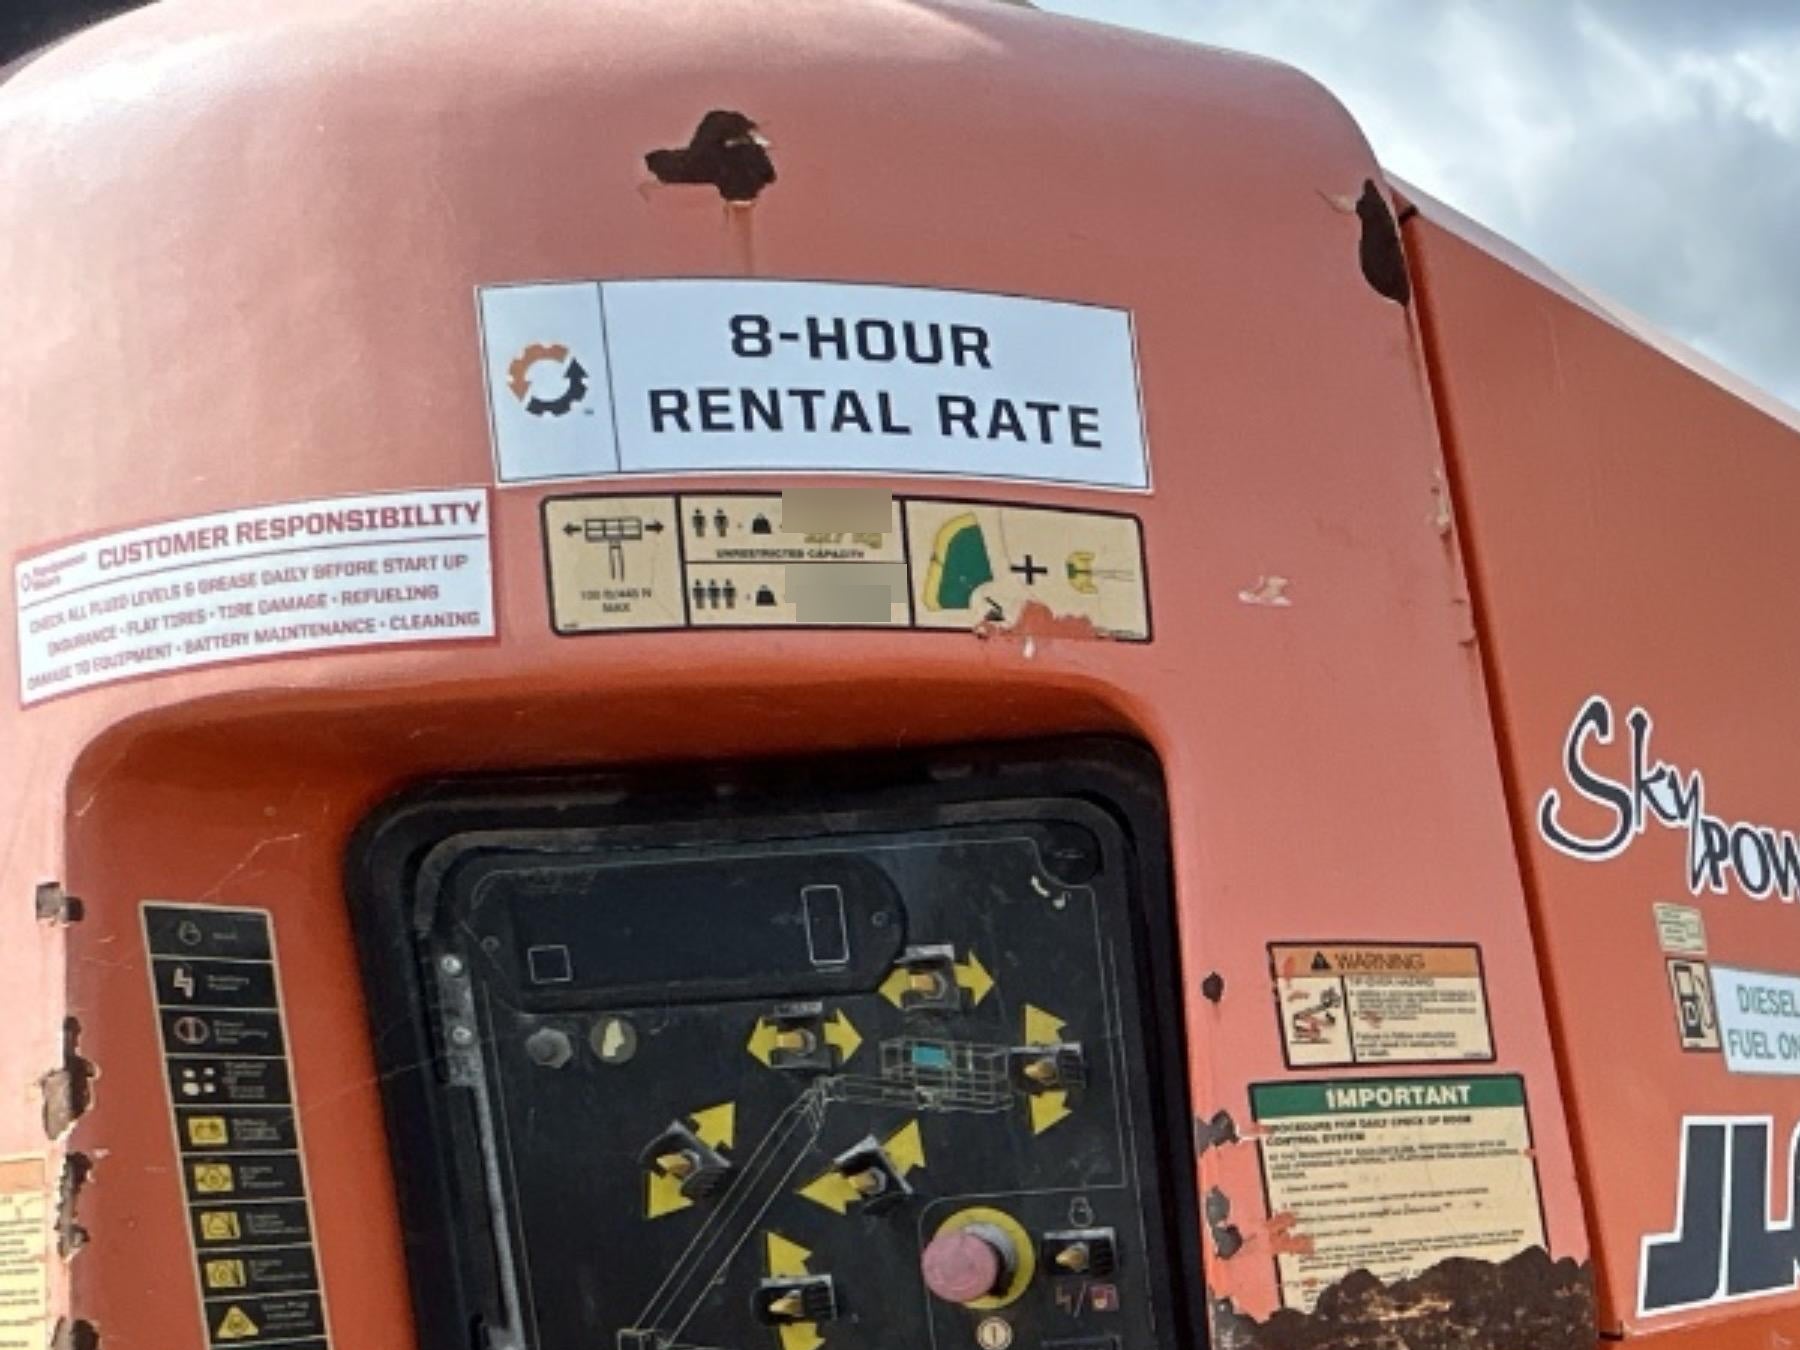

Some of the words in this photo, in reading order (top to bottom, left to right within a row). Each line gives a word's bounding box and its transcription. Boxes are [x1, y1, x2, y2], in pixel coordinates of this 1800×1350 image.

[729, 312, 992, 369] 8-HOUR
[649, 386, 913, 436] RENTAL
[938, 393, 1103, 449] RATE
[98, 525, 229, 570] CUSTOMER
[236, 501, 481, 543] RESPONSIBILITY
[198, 572, 257, 594] GREASE
[260, 566, 307, 586] DAILY
[312, 558, 379, 580] BEFORE
[383, 554, 438, 574] START
[443, 554, 469, 571] UP
[258, 593, 328, 615] DAMAGE
[341, 584, 439, 606] REFUELING
[183, 631, 250, 655] BATTERY
[254, 618, 376, 645] MAINTENANCE
[389, 611, 481, 632] CLEANING
[1333, 952, 1427, 970] WARNING
[1727, 1028, 1776, 1060] FUEL
[1325, 1084, 1472, 1110] IMPORTANT
